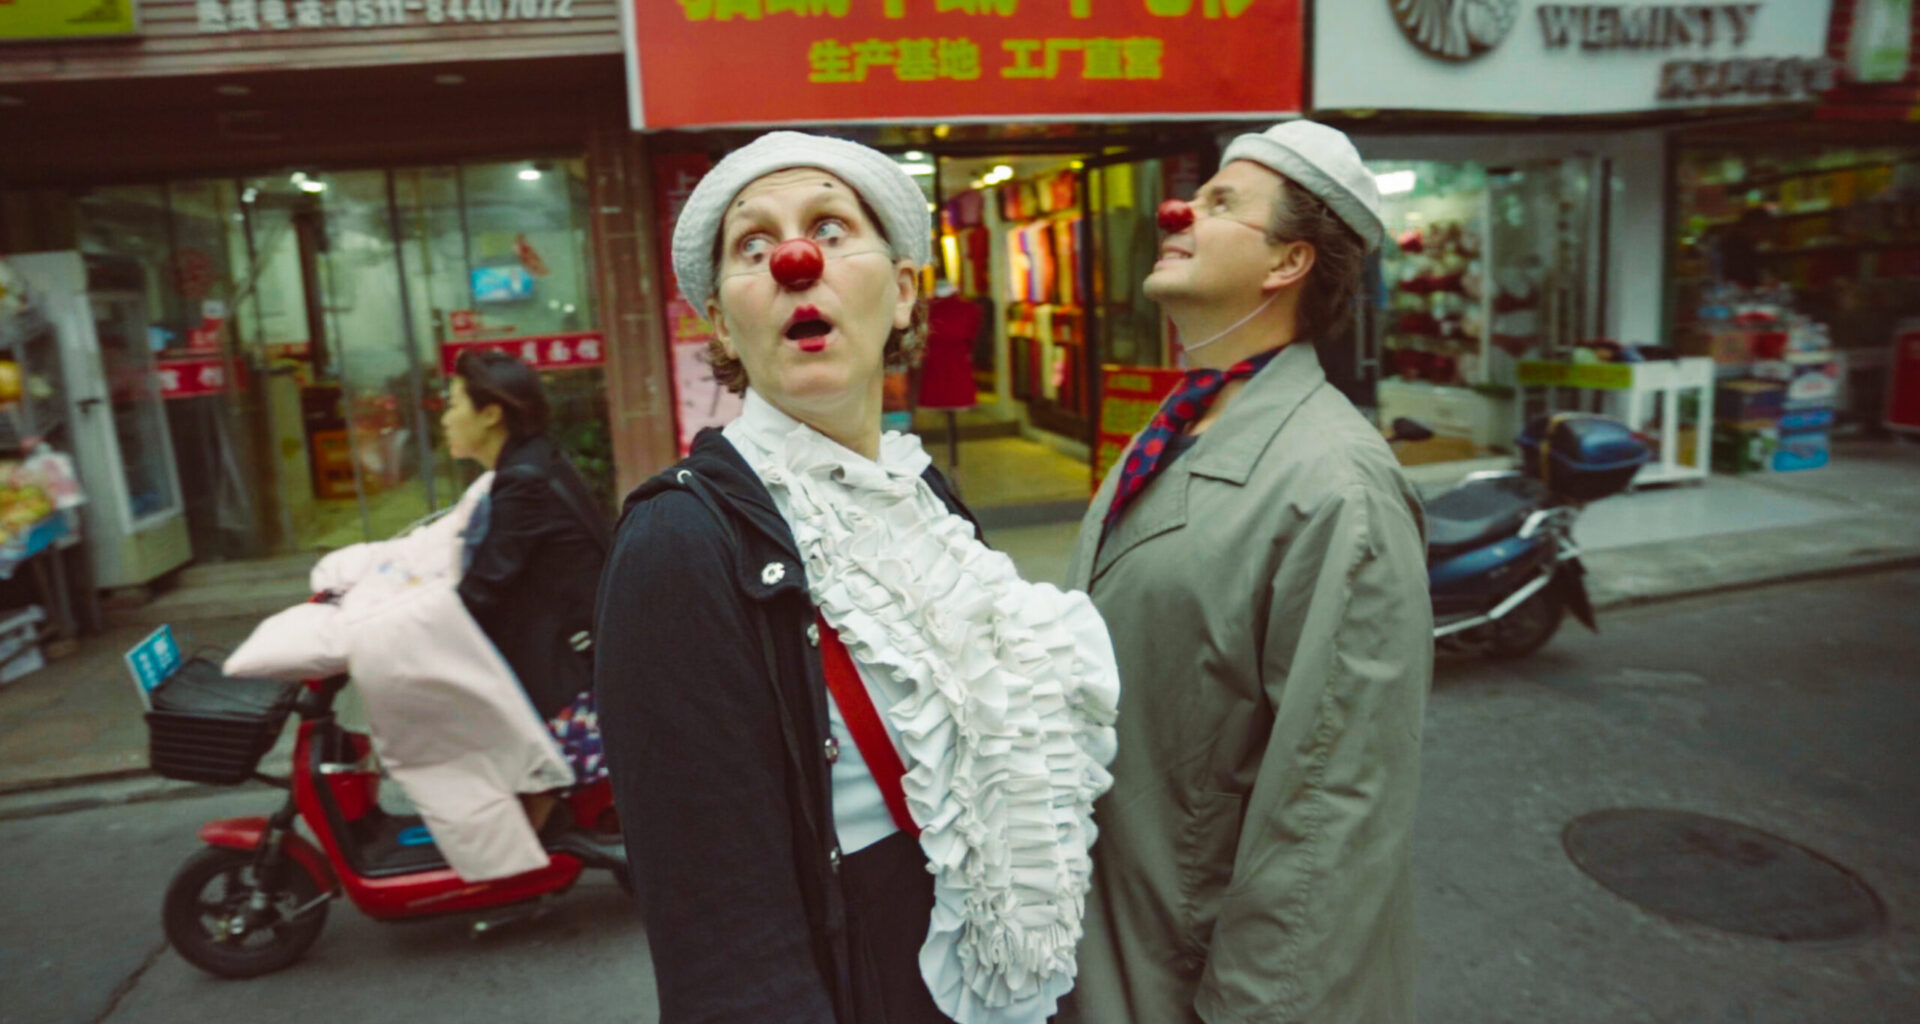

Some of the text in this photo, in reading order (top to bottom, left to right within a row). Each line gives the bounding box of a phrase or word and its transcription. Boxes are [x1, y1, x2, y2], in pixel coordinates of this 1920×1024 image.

[808, 36, 1162, 82] 生产基地 工厂直营
